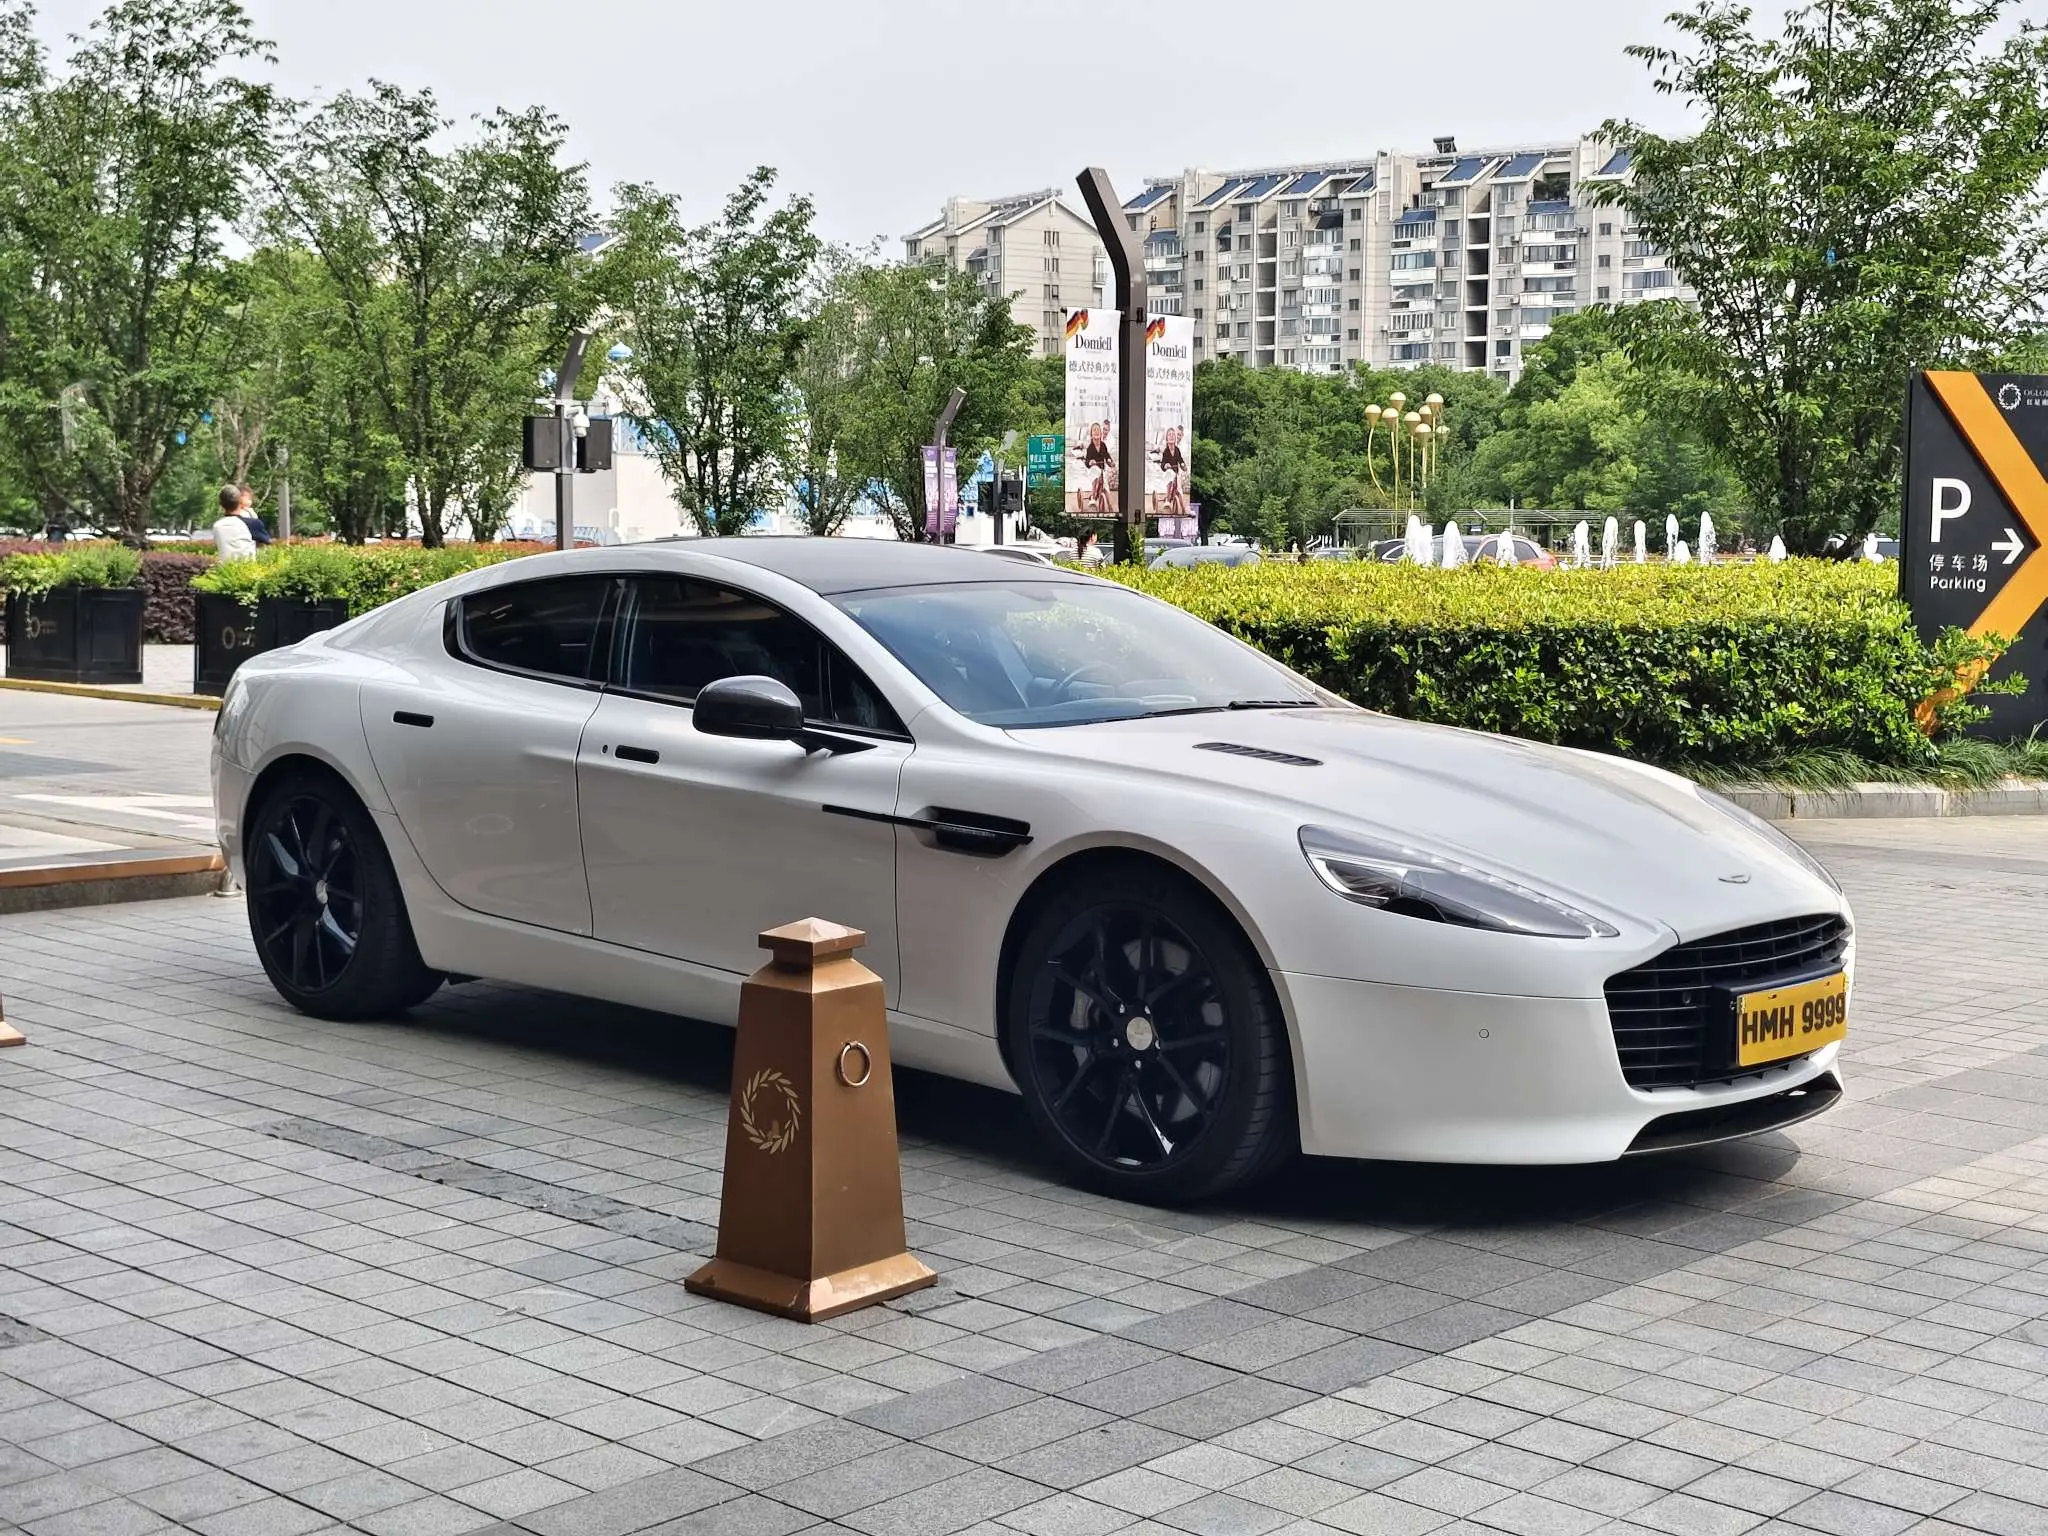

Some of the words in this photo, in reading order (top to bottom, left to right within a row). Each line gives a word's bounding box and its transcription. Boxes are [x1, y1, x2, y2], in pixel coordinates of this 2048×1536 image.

[1075, 334, 1112, 350] Domicil
[1069, 360, 1117, 374] 德式经典沙发
[1930, 477, 1972, 543] P
[1929, 554, 1988, 571] 停车场
[1930, 576, 1986, 592] Parking
[1742, 1005, 1795, 1045] HMH
[1802, 992, 1846, 1033] 9999
